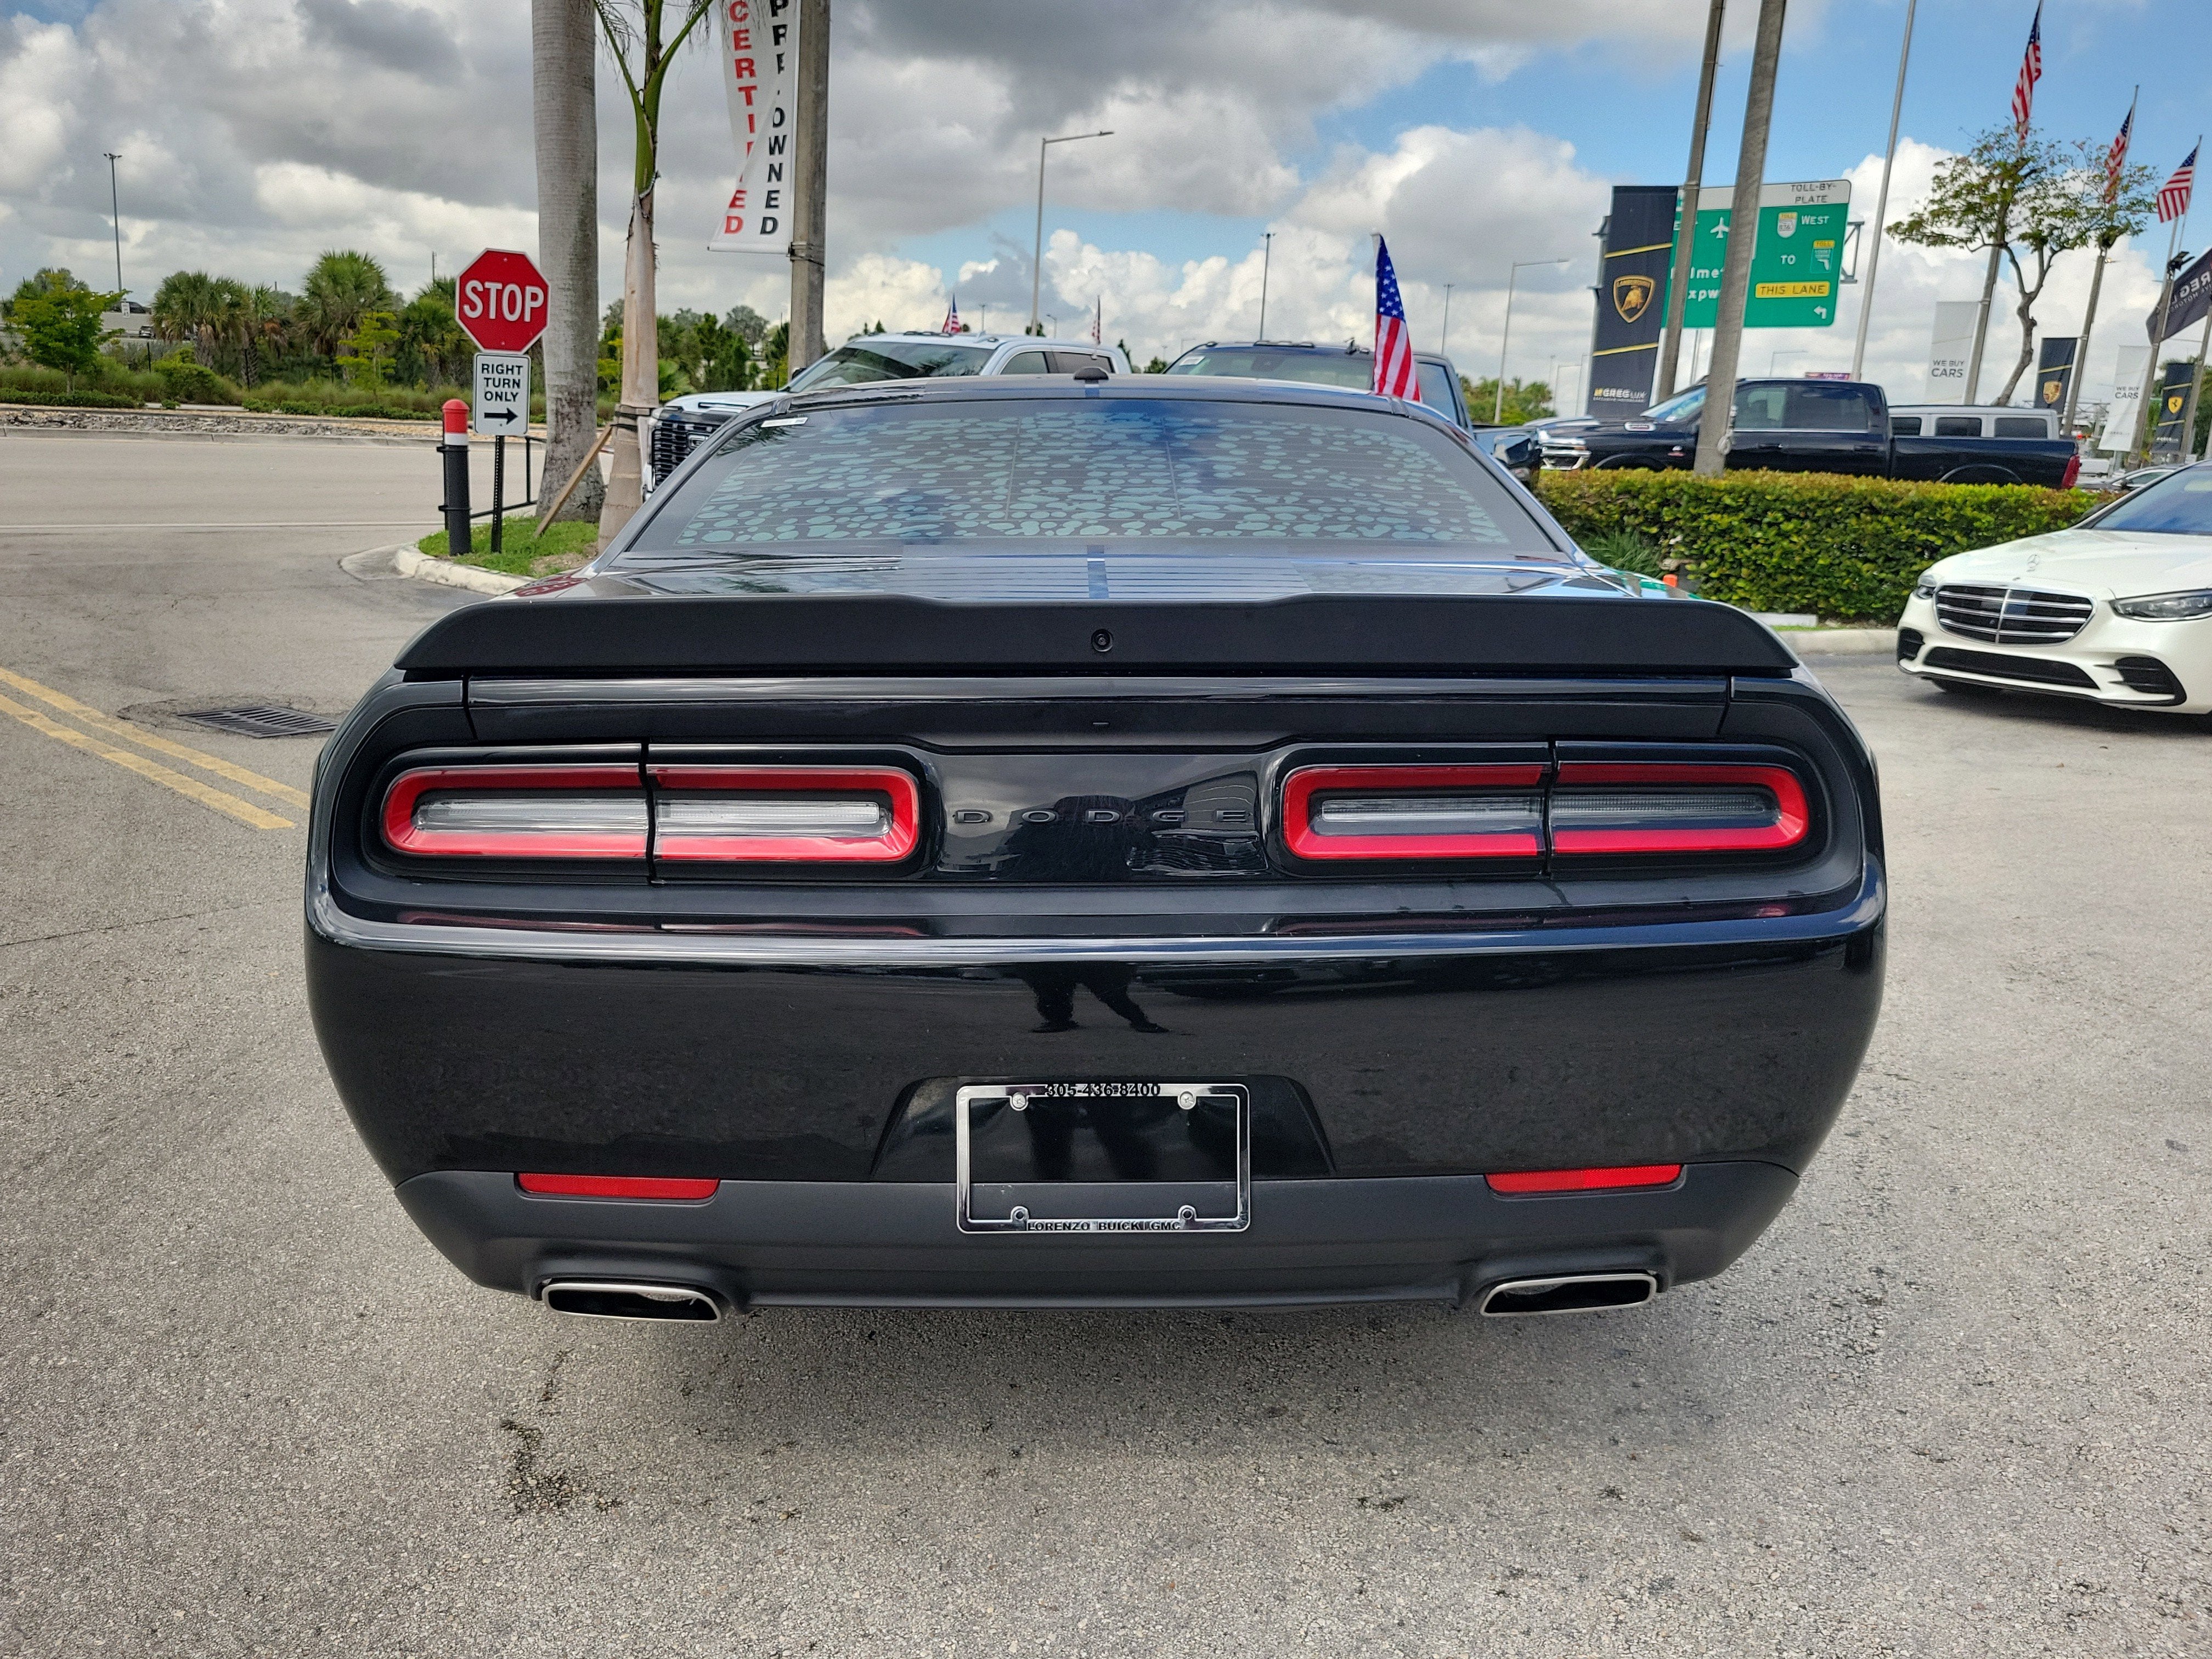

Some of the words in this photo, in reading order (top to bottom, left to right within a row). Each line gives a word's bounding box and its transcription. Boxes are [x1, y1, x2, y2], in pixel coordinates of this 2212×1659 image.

[725, 0, 758, 235] CERTIED
[1795, 195, 1828, 204] PLATE
[1801, 215, 1830, 225] WEST
[1780, 254, 1797, 265] TO
[1687, 289, 1720, 302] xpw
[1760, 285, 1786, 295] THIS
[1792, 285, 1826, 295] LANE
[463, 280, 545, 323] STOP
[481, 363, 523, 375] RIGHT
[1931, 368, 1963, 377] CARS
[484, 377, 521, 388] TURN
[484, 391, 519, 402] ONLY
[955, 809, 1250, 823] DODGE
[1044, 1084, 1161, 1097] 305-436-8400
[1028, 1221, 1091, 1231] LORENZO
